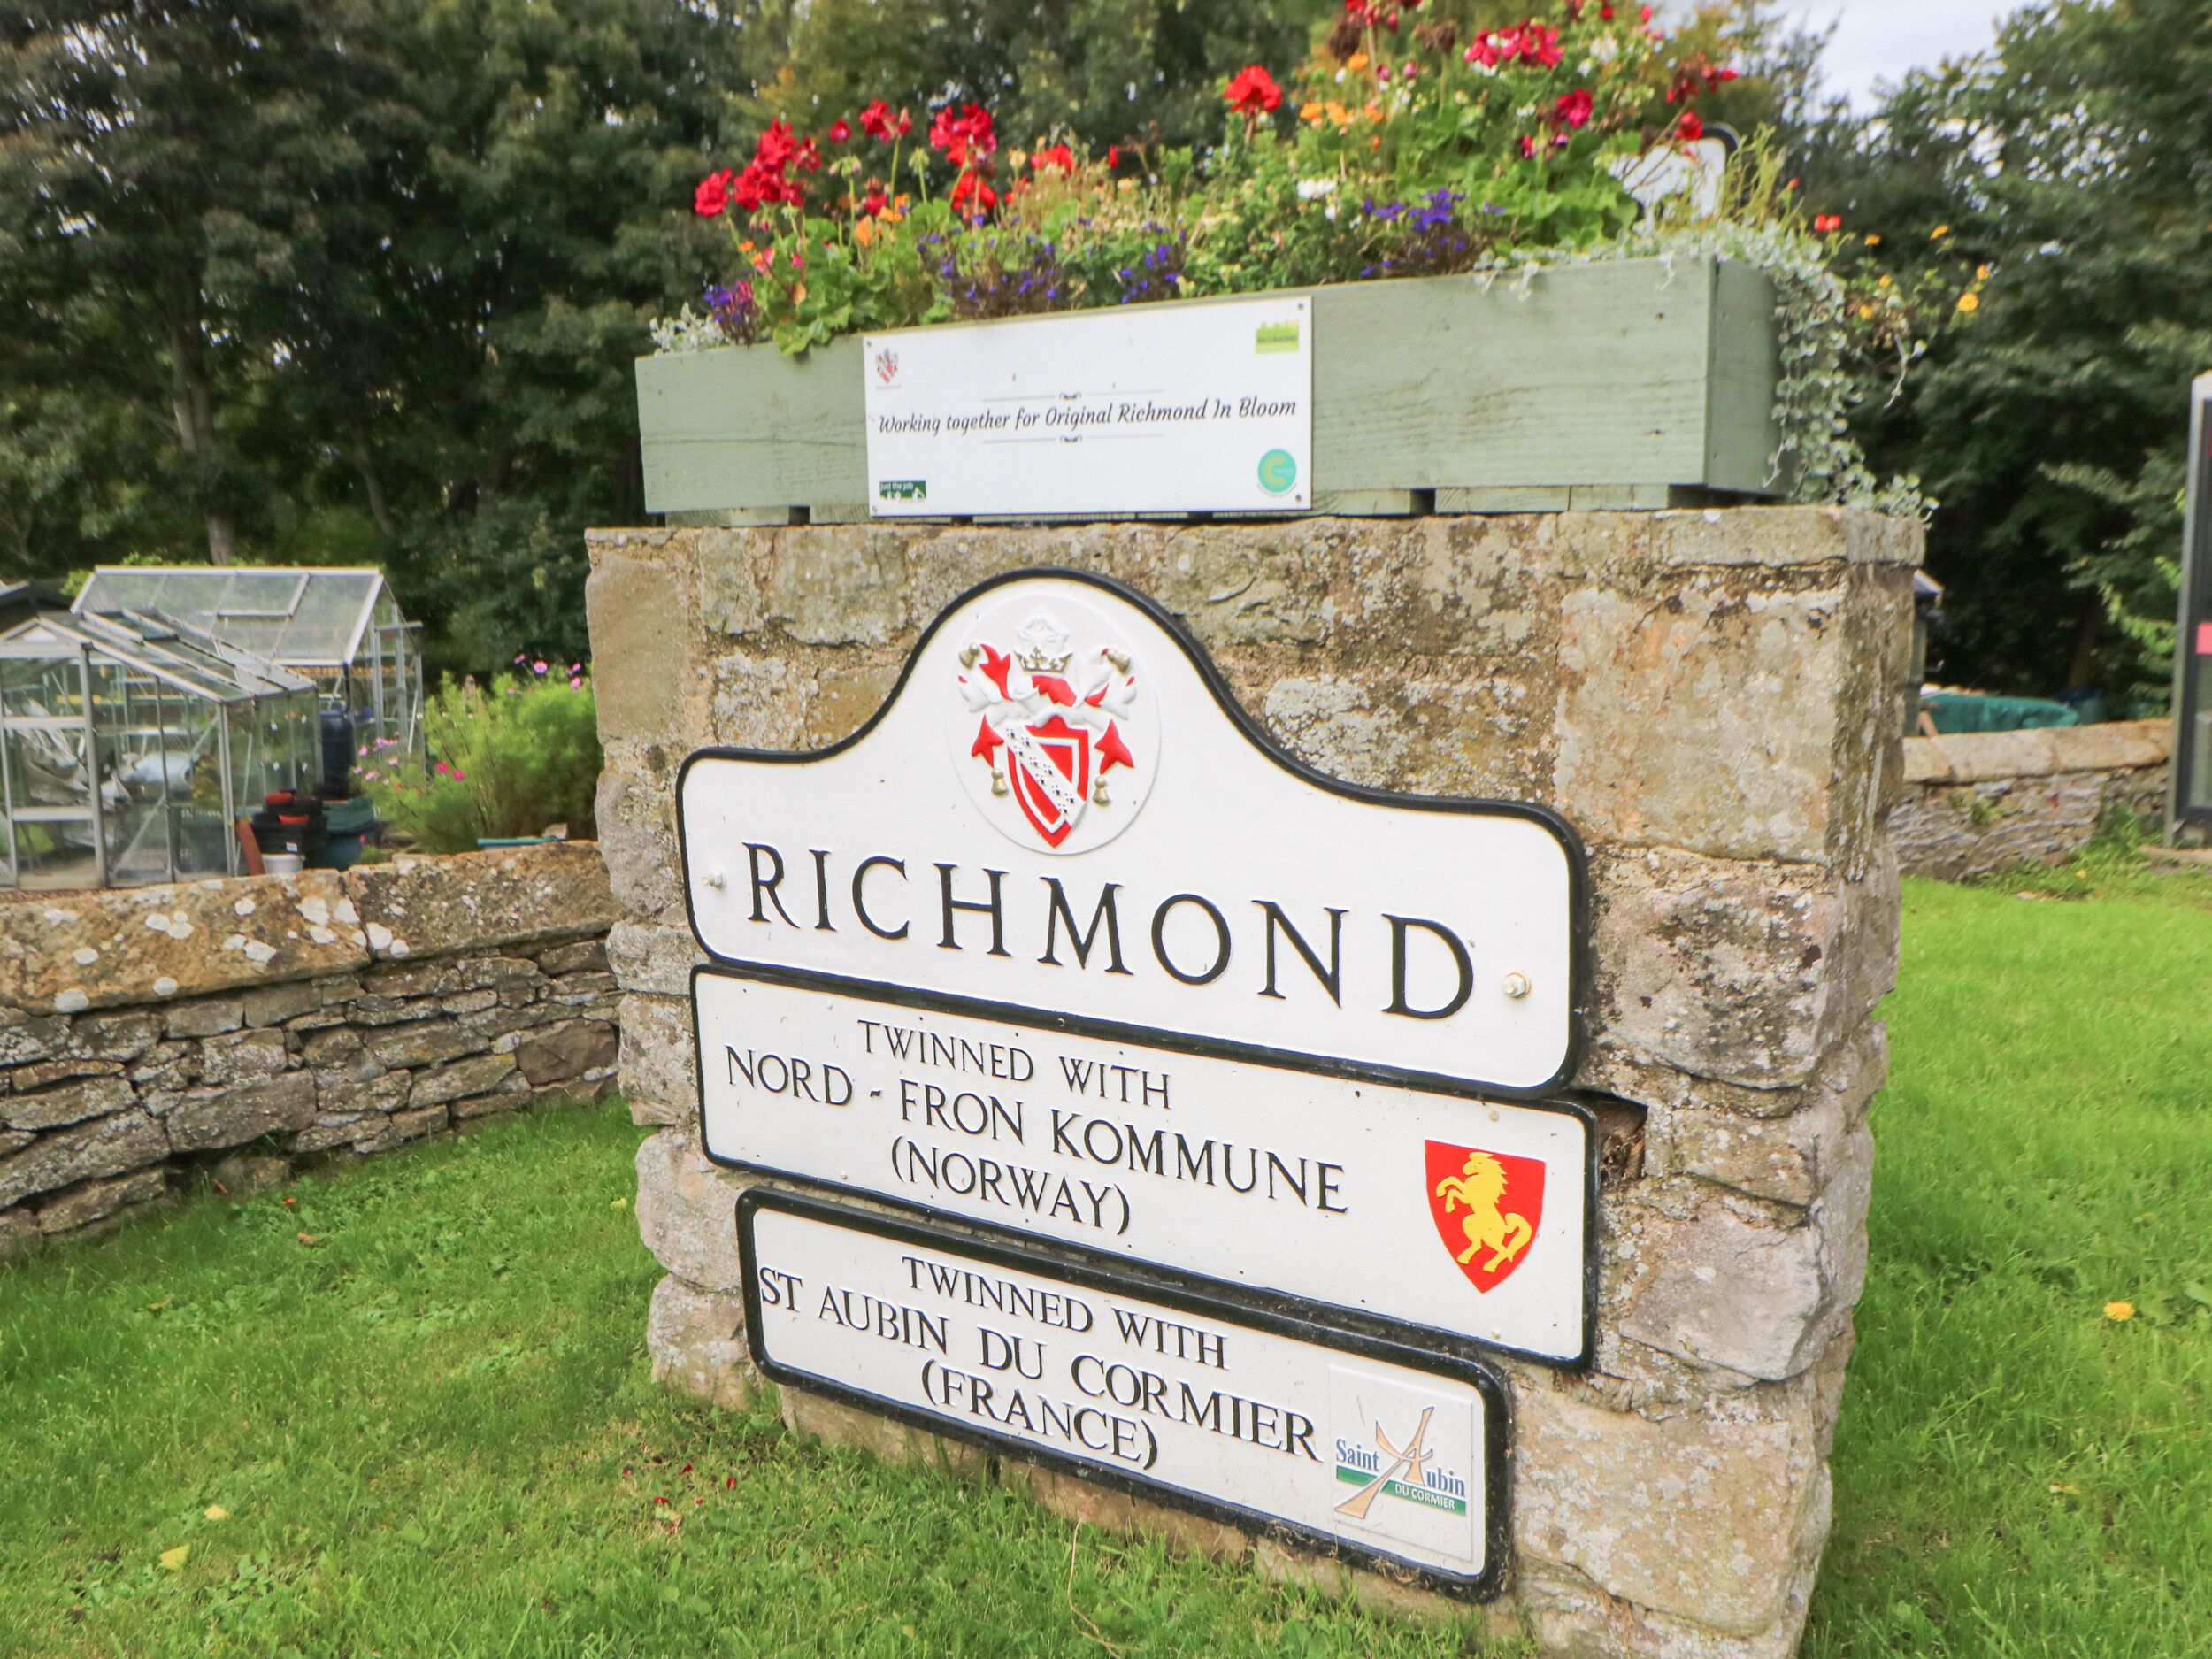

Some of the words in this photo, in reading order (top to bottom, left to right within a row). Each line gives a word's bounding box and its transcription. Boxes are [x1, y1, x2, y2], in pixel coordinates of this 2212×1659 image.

[879, 413, 941, 436] Working
[946, 409, 1010, 436] together
[1015, 407, 1041, 431] for
[1045, 403, 1111, 431] Original
[1118, 398, 1209, 423] Richmond
[1212, 399, 1232, 419] In
[1239, 396, 1297, 419] Bloom
[741, 841, 1474, 1020] RICHMOND
[857, 1018, 1033, 1082] TWINNED
[1059, 1056, 1171, 1110] WITH
[724, 1043, 853, 1106] NORD
[899, 1078, 1025, 1145] FRON
[1050, 1108, 1349, 1214] KOMMUNE
[891, 1134, 1130, 1235] (NORWAY)
[758, 1266, 803, 1312] ST
[818, 1286, 949, 1355] AUBIN
[978, 1326, 1047, 1379] DU
[1071, 1354, 1324, 1463] CORMIER
[902, 1256, 1094, 1333] TWINNED
[1111, 1306, 1229, 1370] WITH
[921, 1357, 1158, 1471] (FRANCE)
[1336, 1438, 1379, 1472] Saint
[1394, 1483, 1409, 1496] DU
[1411, 1488, 1456, 1510] CORMIER
